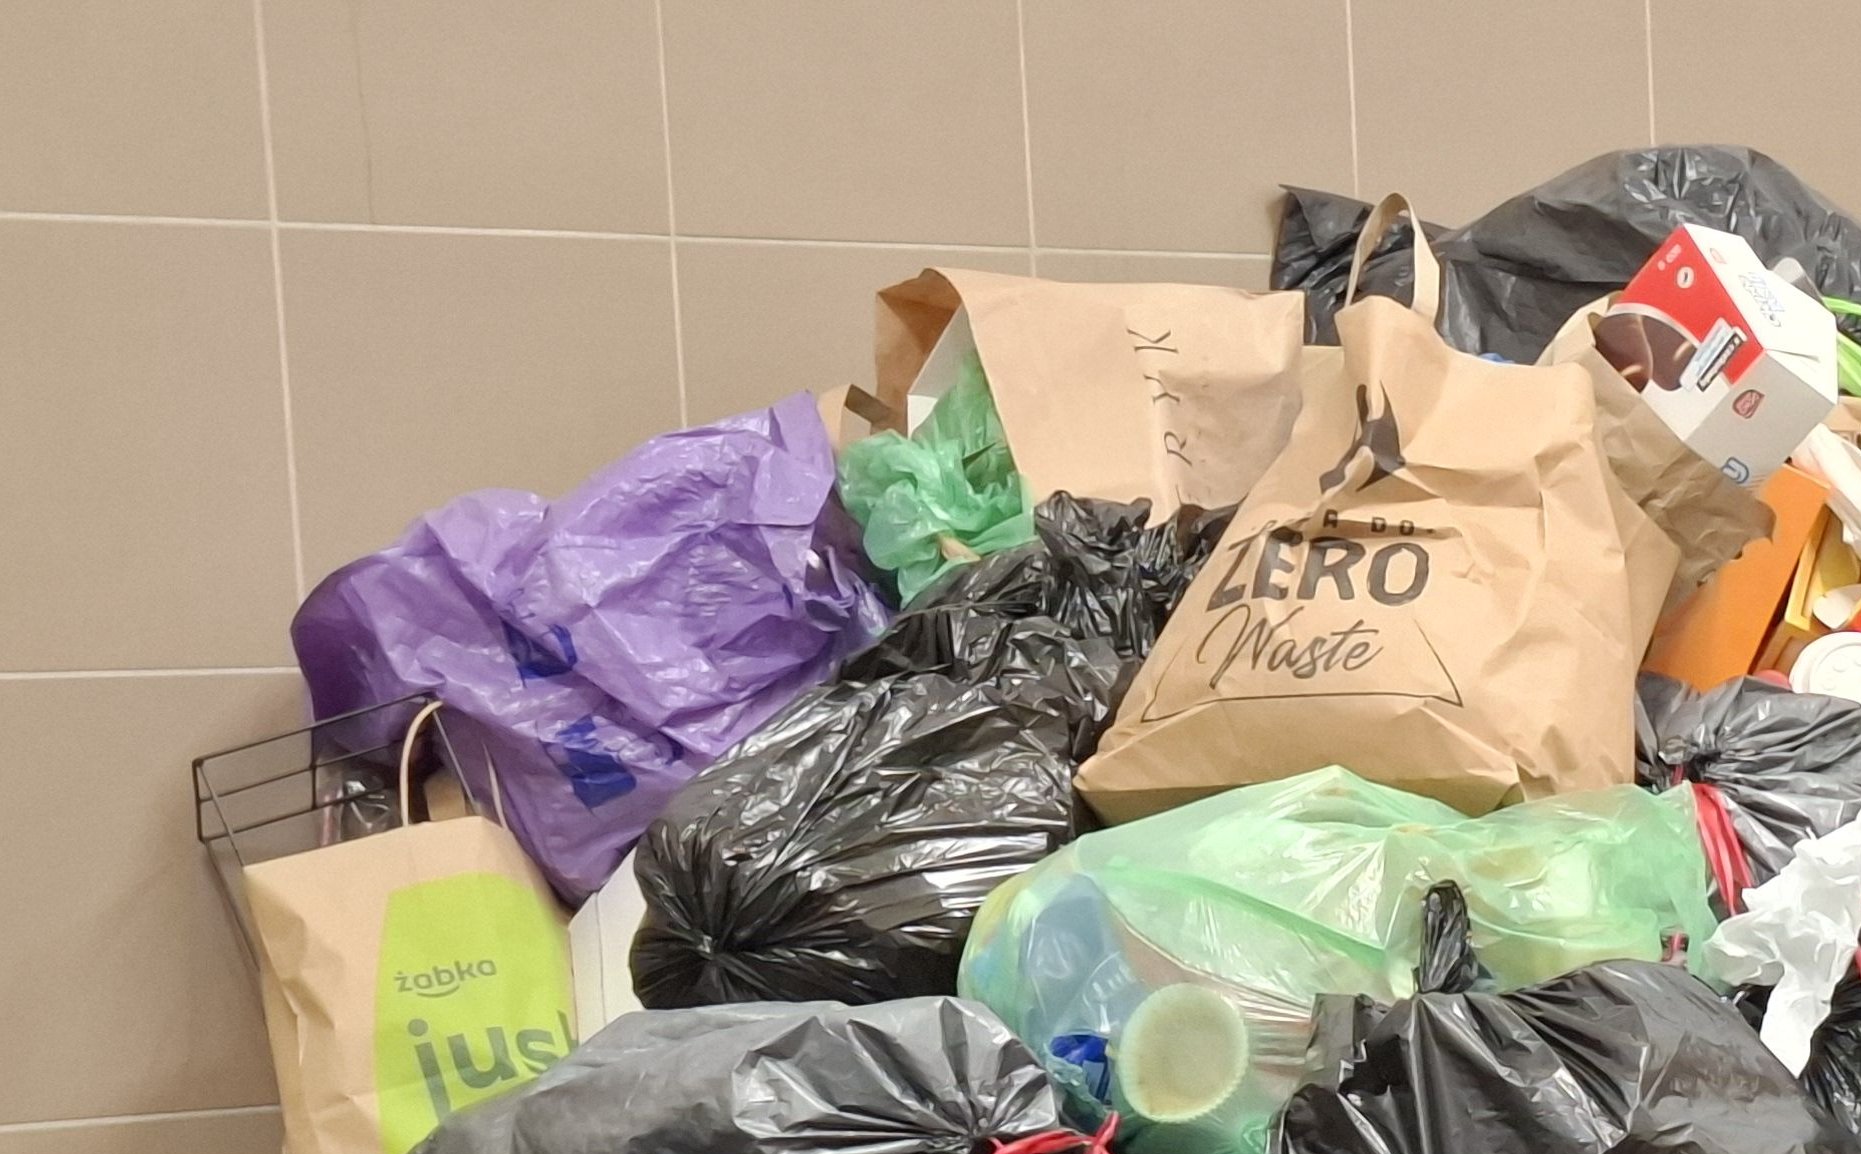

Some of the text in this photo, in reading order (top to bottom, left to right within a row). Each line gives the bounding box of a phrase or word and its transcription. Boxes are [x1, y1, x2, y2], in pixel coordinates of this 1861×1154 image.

[1126, 328, 1193, 467] RYK
[1205, 533, 1430, 613] ZERO
[1195, 602, 1385, 691] Waste
[393, 959, 498, 993] żabka
